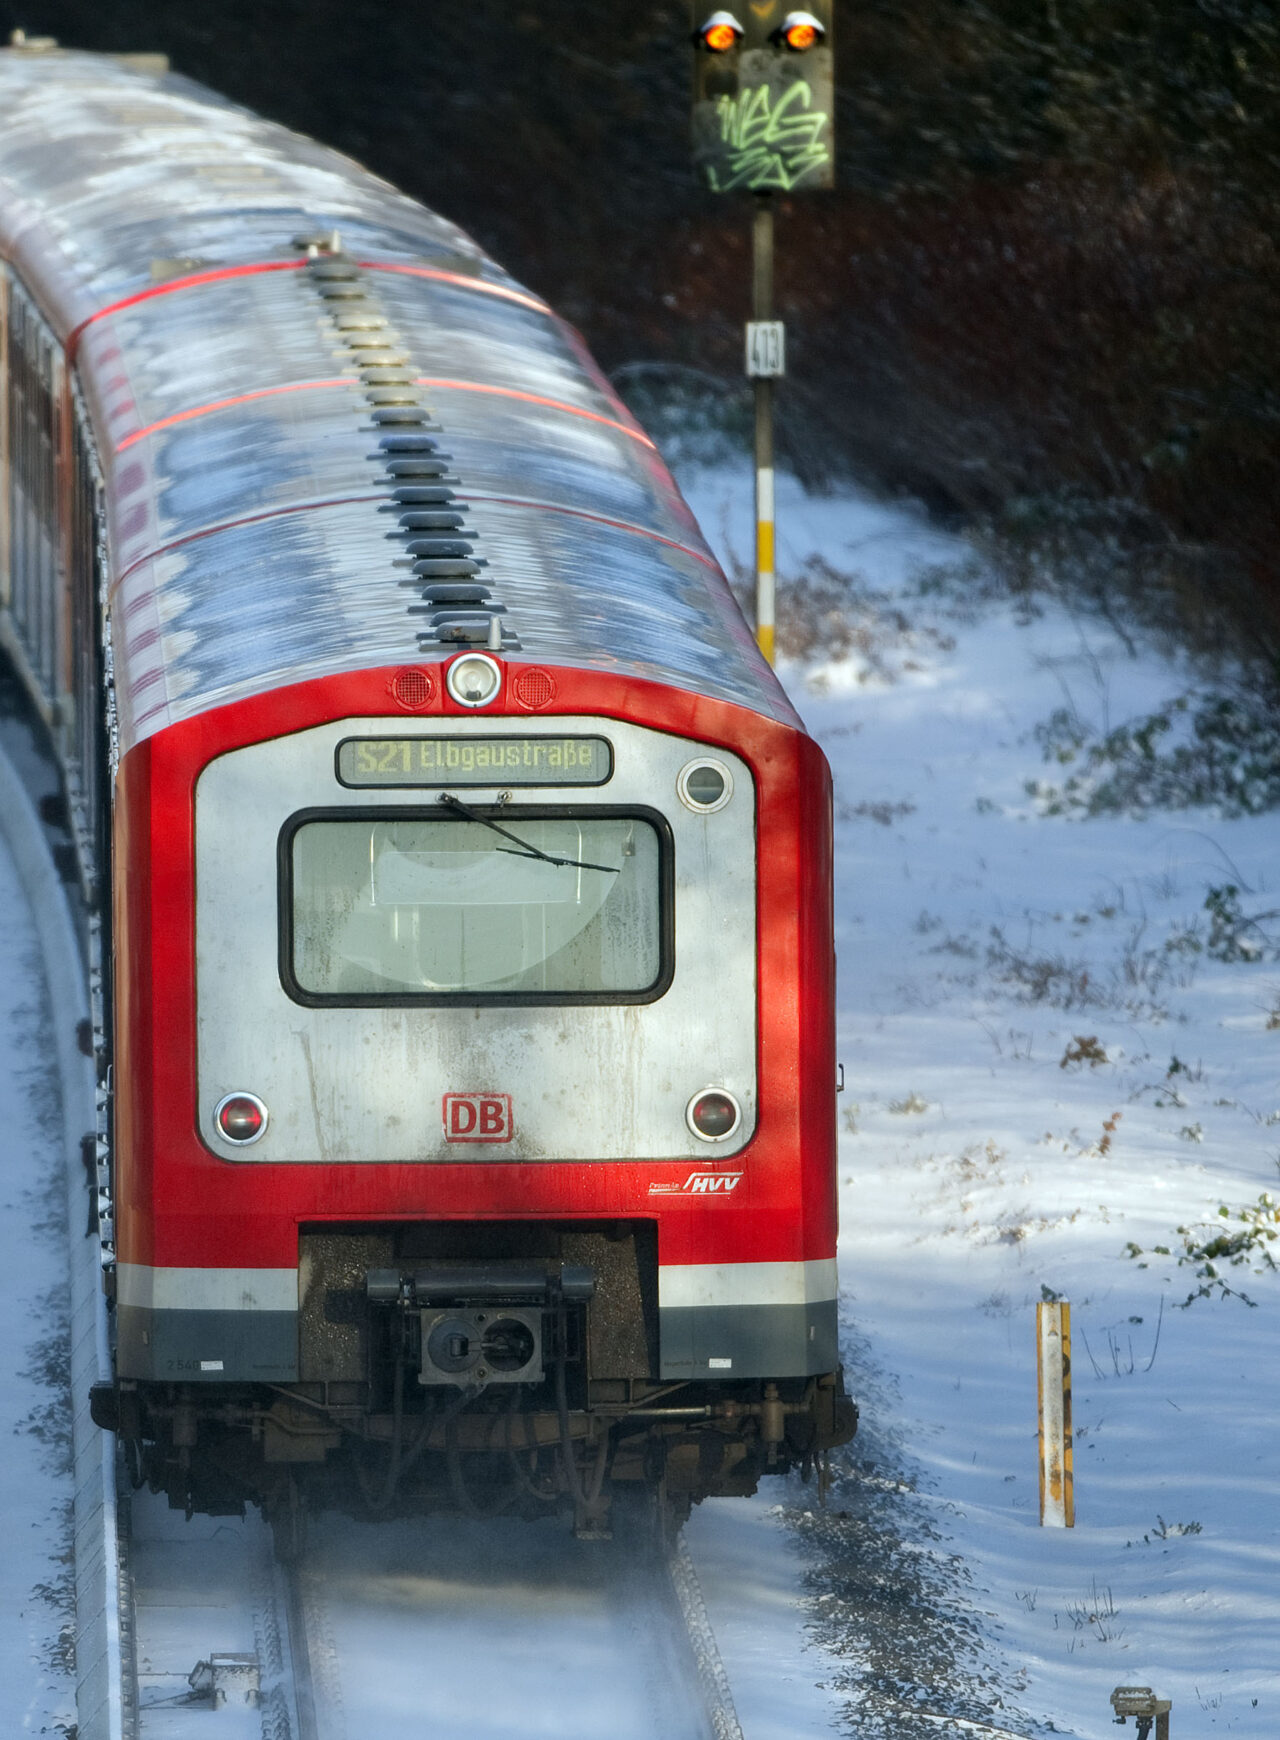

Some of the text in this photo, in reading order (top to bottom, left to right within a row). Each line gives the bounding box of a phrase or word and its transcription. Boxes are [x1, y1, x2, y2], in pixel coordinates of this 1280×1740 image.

[357, 740, 592, 772] S21 Elbgaustraße
[451, 1100, 505, 1134] DB
[691, 1177, 740, 1193] HVV
